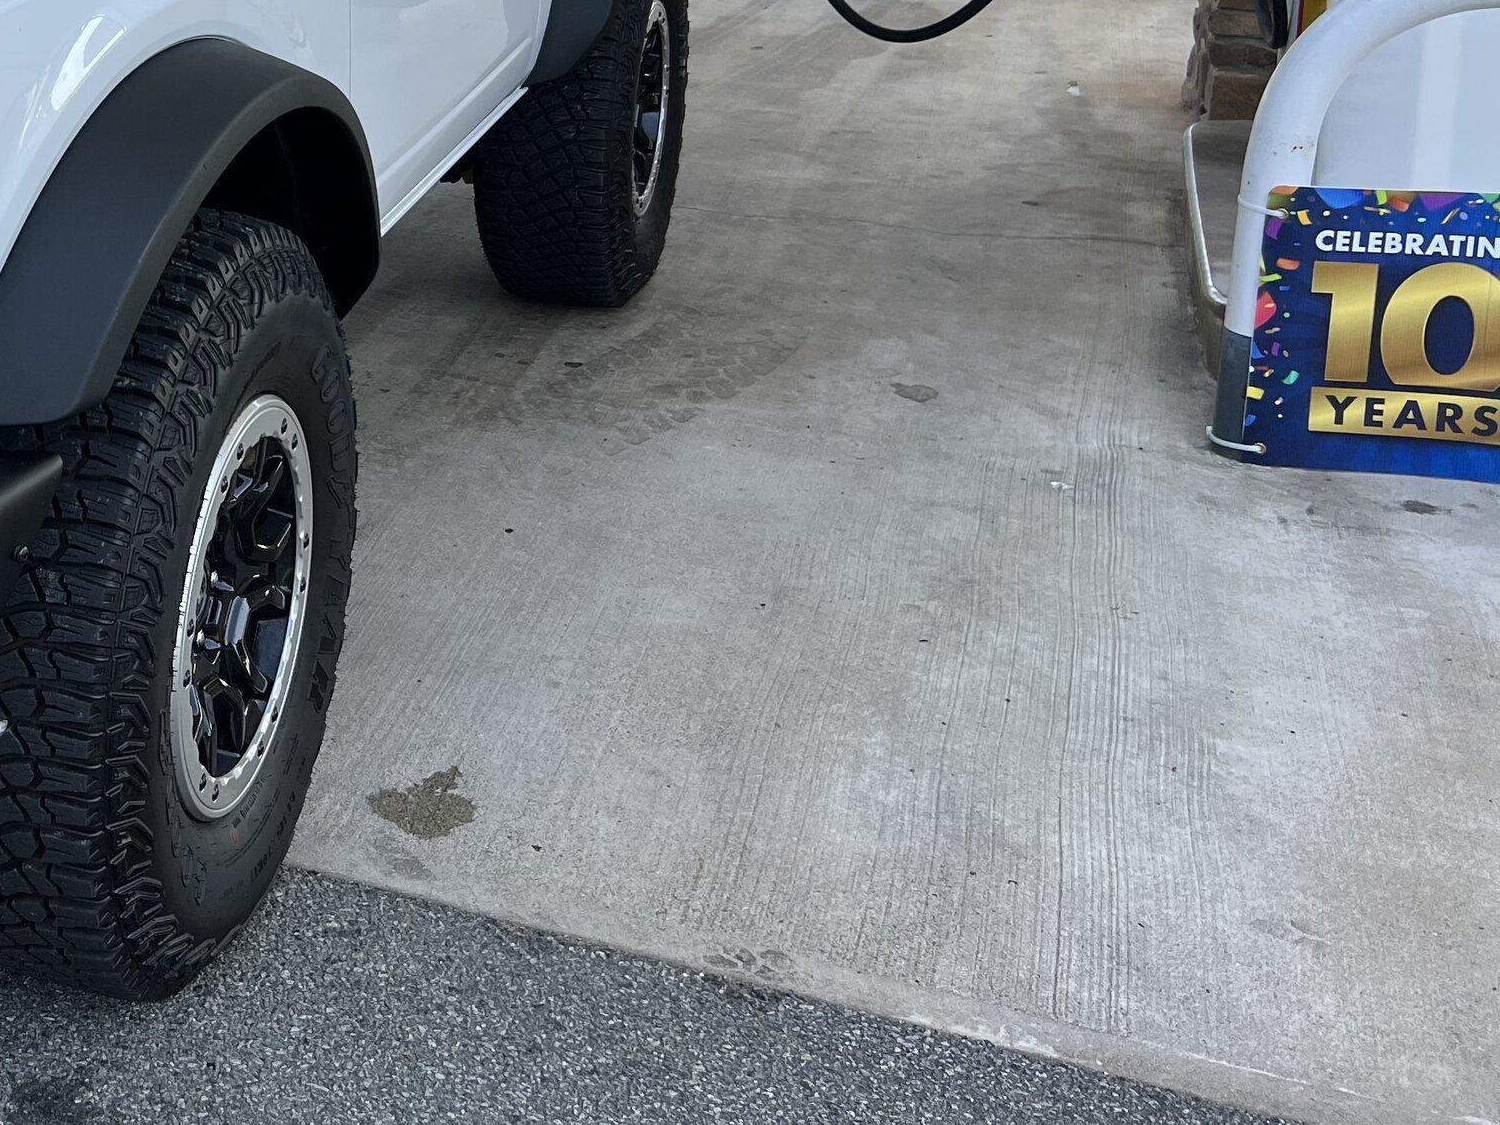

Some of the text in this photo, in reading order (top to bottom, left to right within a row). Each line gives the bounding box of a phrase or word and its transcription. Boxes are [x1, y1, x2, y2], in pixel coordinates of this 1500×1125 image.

[1315, 229, 1500, 259] CELEBRATIN
[1311, 260, 1500, 392] 10
[1325, 394, 1500, 438] YEARS
